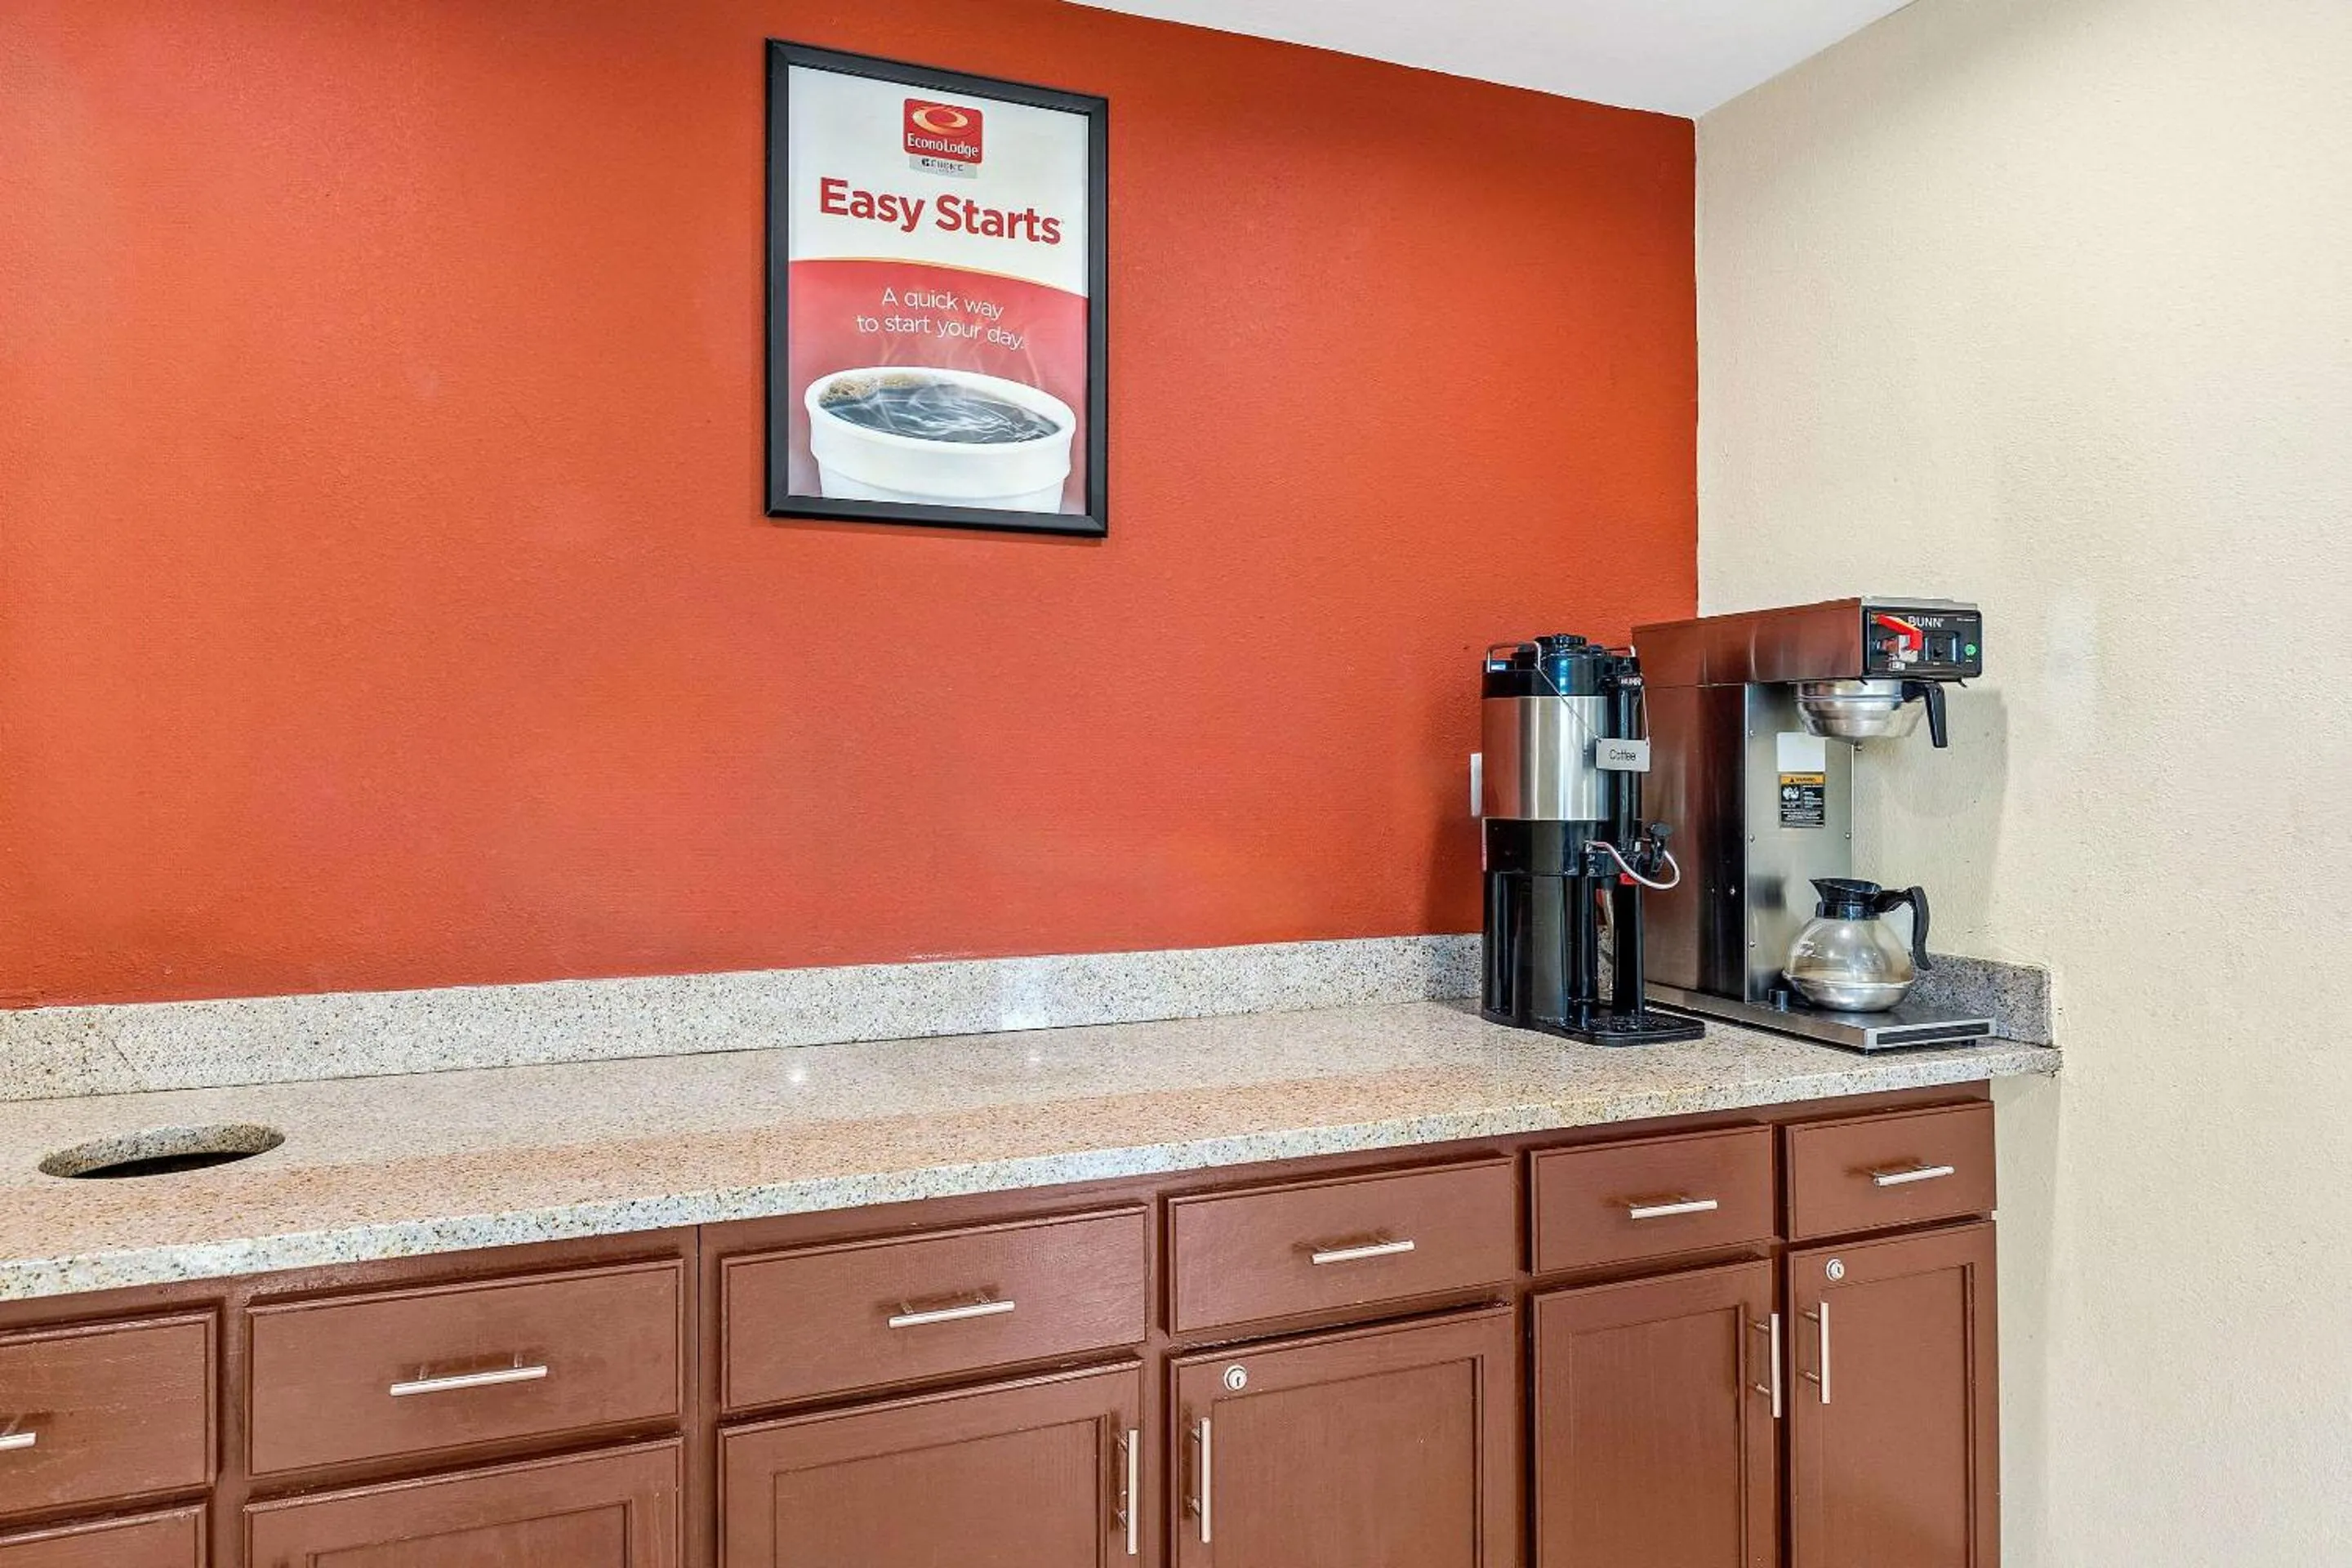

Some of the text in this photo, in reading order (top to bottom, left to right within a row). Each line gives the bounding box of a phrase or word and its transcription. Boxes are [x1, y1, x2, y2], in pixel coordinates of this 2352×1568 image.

[907, 133, 979, 157] EconoLodge
[821, 177, 1061, 244] Easy Starts
[882, 287, 1004, 320] A quick way
[857, 314, 1024, 350] to start your day.
[1609, 749, 1636, 761] Coffee
